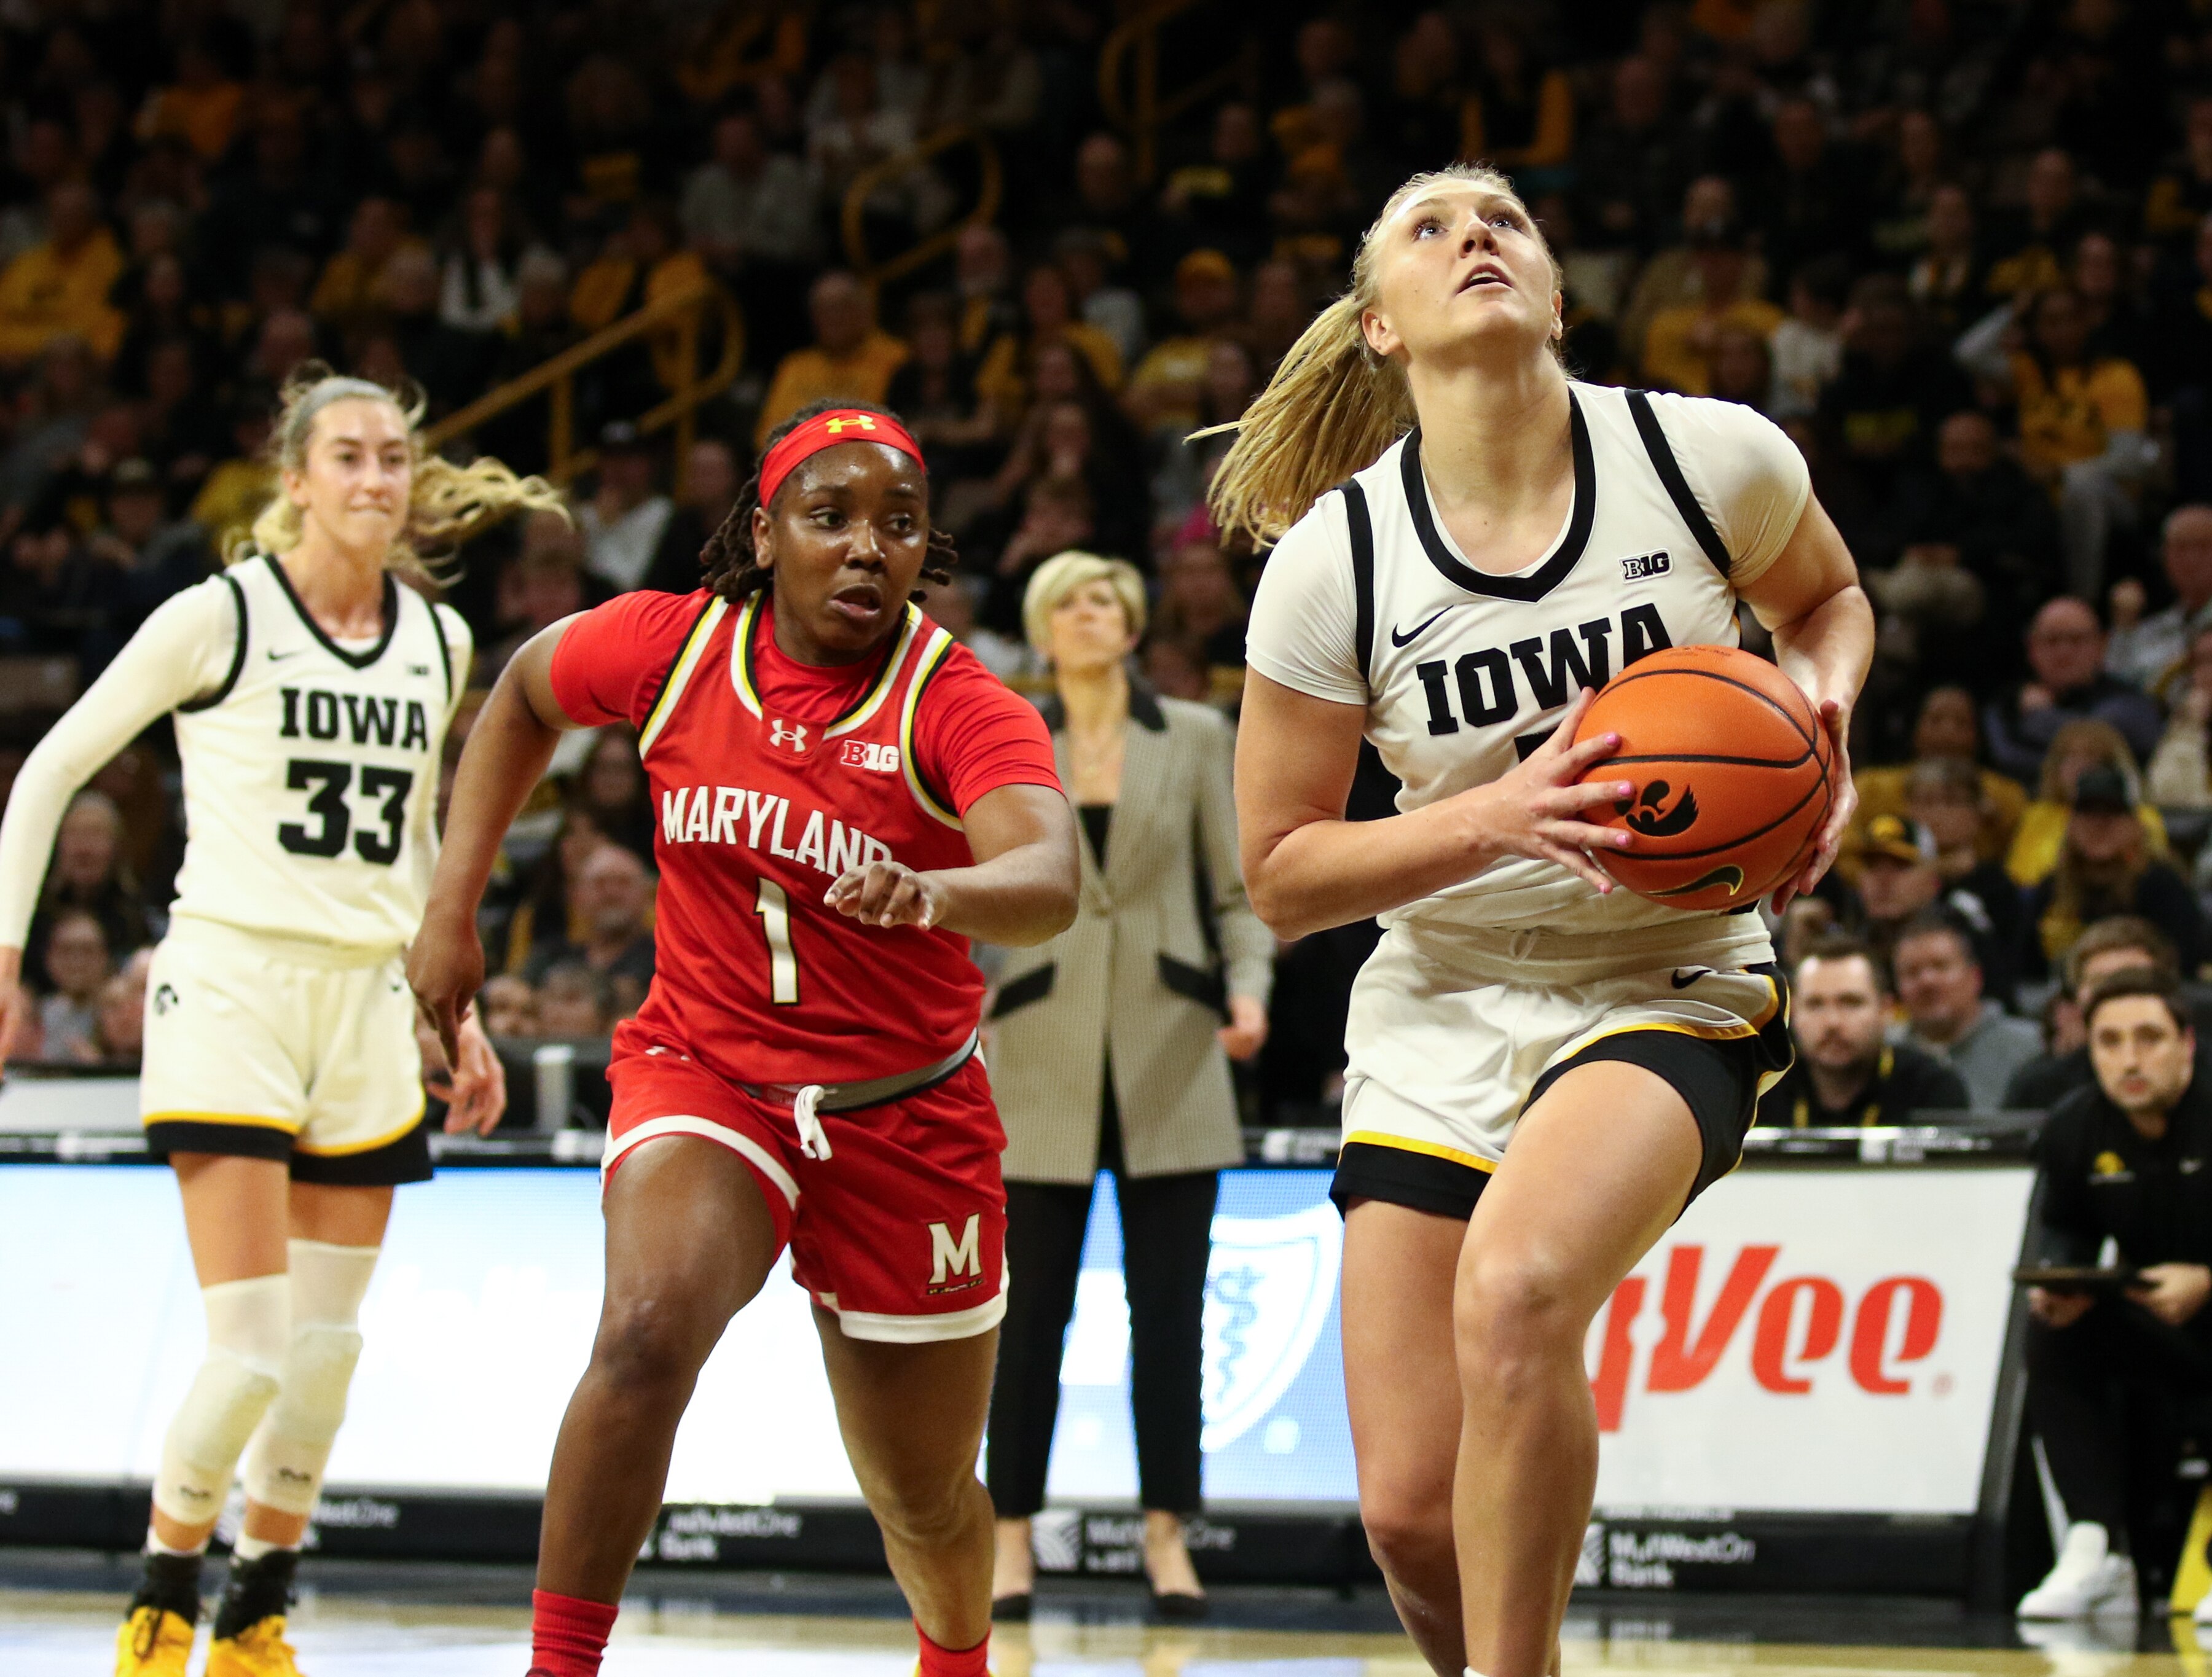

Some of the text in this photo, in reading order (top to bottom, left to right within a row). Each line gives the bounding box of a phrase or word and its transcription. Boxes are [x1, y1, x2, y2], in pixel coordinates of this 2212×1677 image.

[280, 687, 428, 752] IOWA
[1416, 603, 1673, 735] IOWA
[278, 758, 414, 866] 33
[753, 877, 799, 1006] 1
[927, 1211, 982, 1285] M
